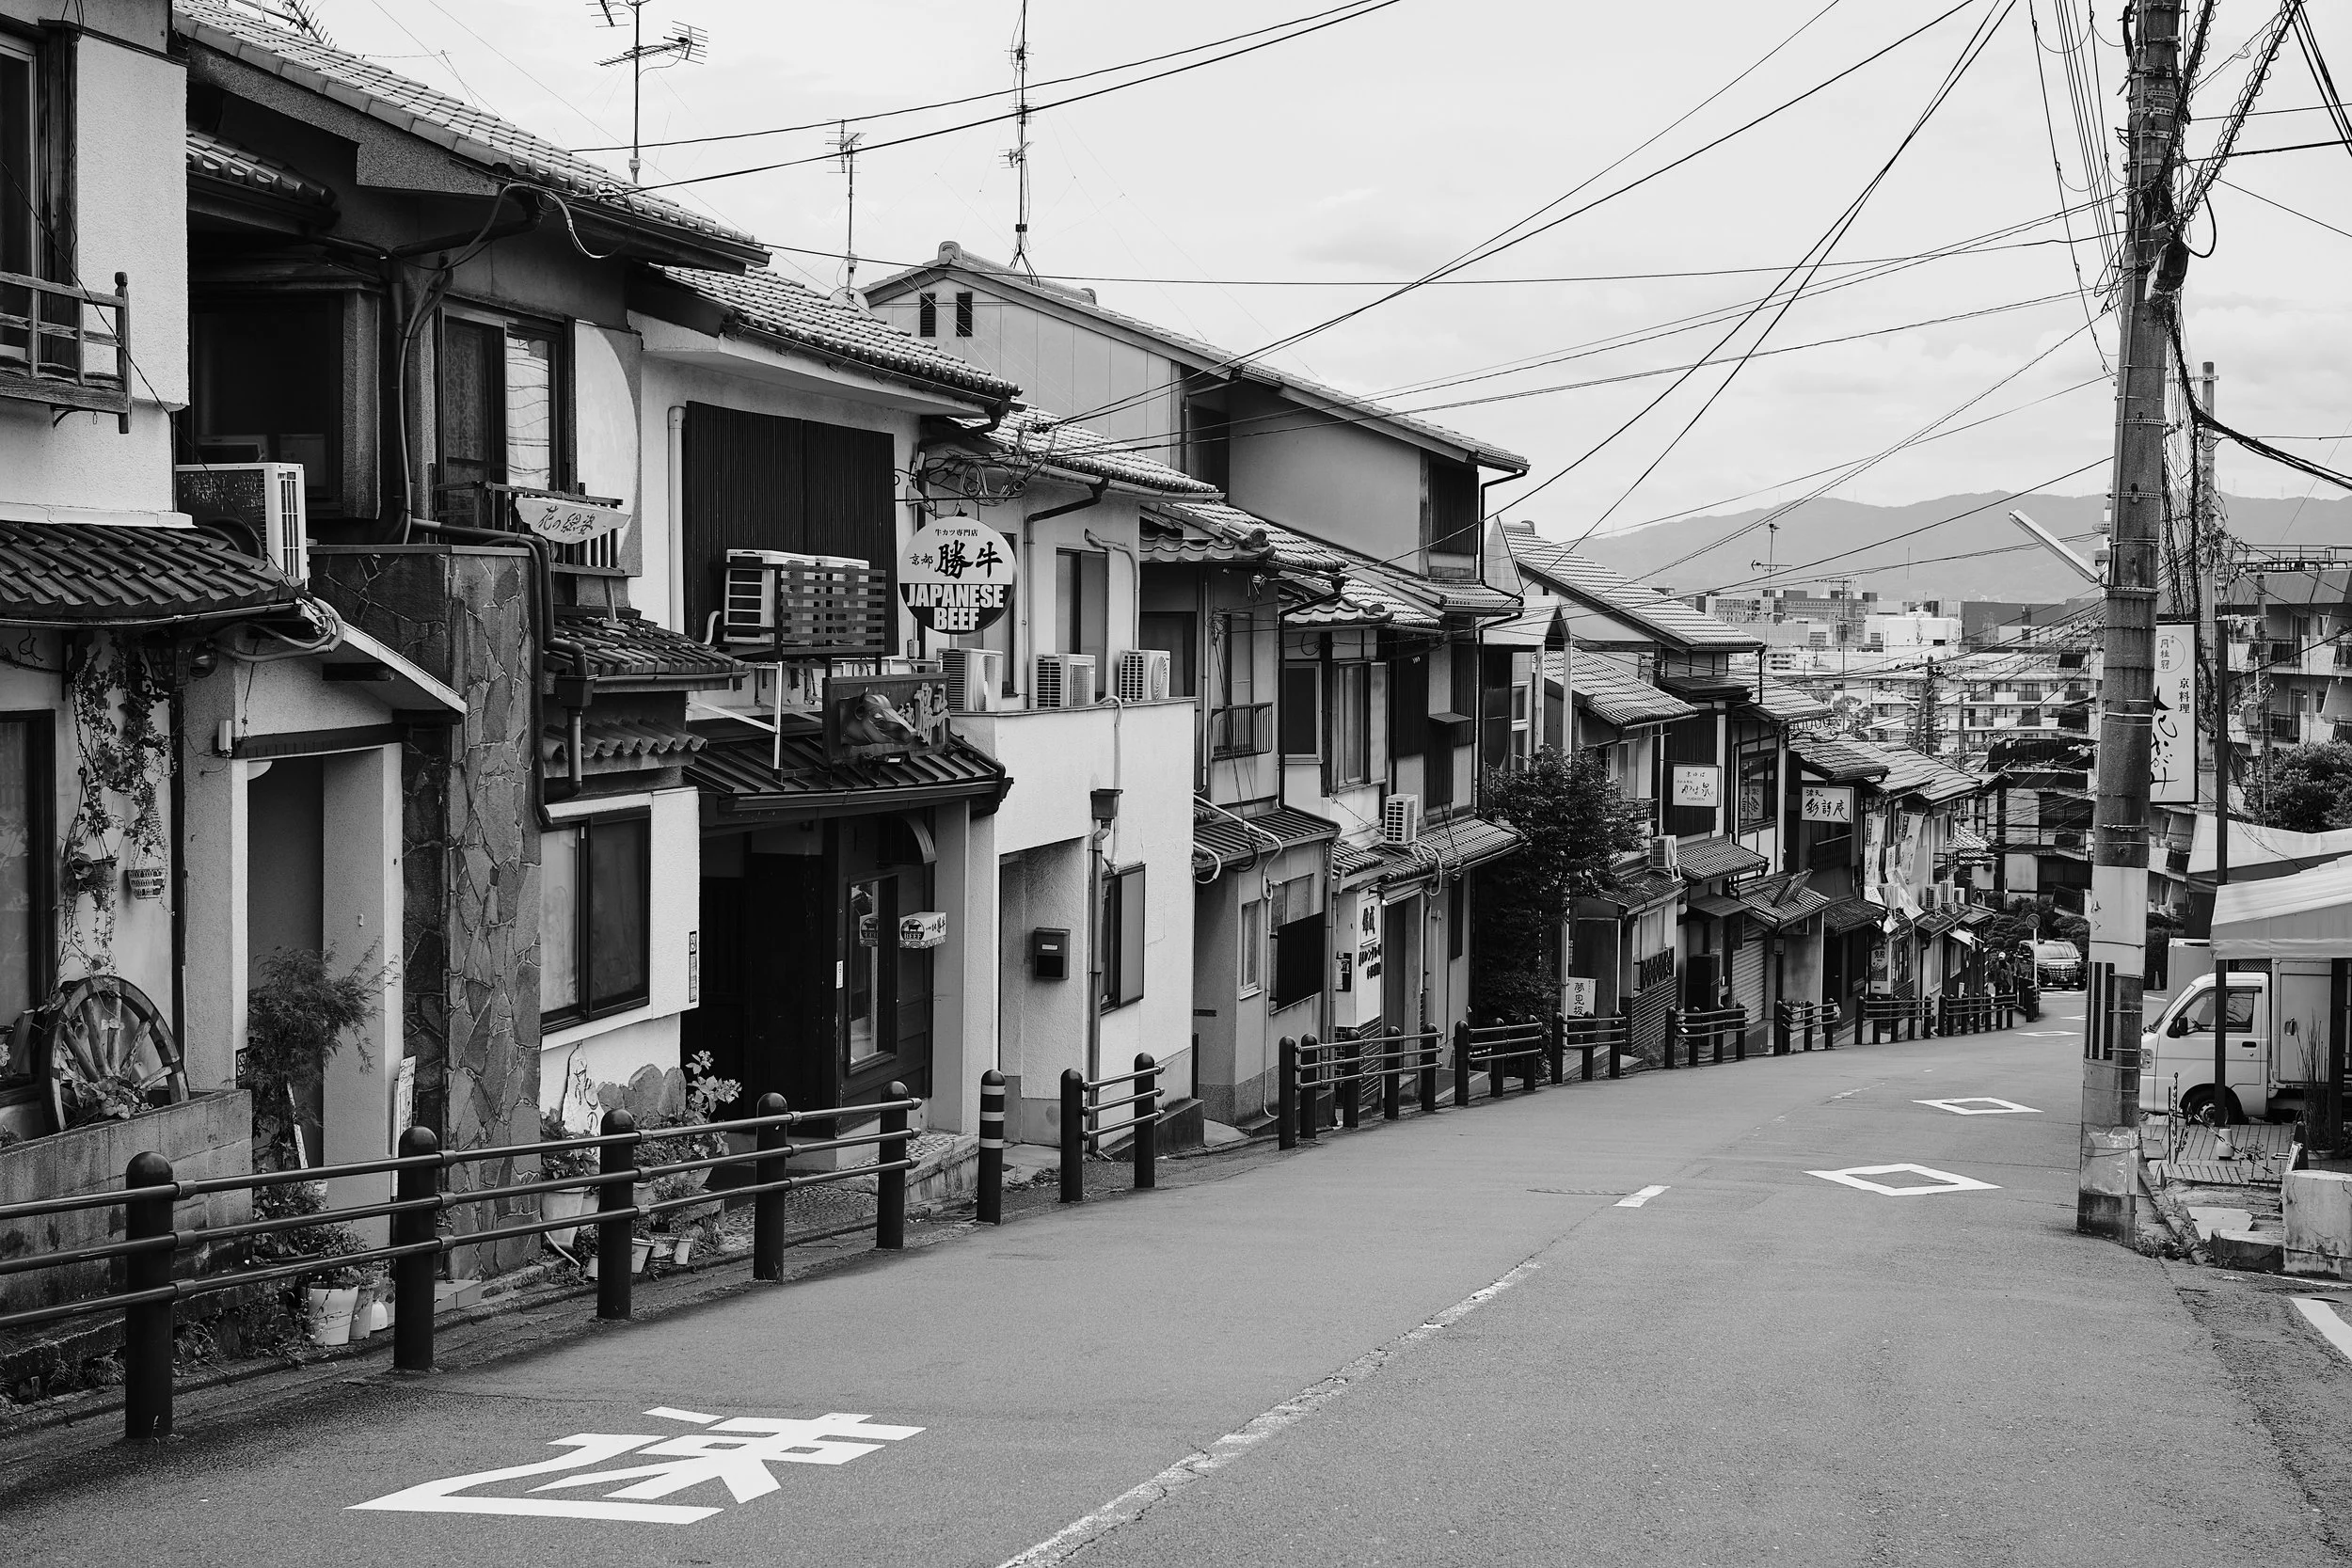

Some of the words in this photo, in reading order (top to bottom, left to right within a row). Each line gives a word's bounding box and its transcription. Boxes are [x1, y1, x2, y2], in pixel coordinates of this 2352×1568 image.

[934, 529, 978, 537] 牛カツ専門店
[909, 553, 933, 569] 京都
[934, 539, 1004, 579] 勝牛
[907, 583, 1004, 608] JAPANESE
[933, 607, 979, 631] BEEF
[2179, 677, 2190, 713] 京料理
[1574, 982, 1584, 1016] 夢見坂
